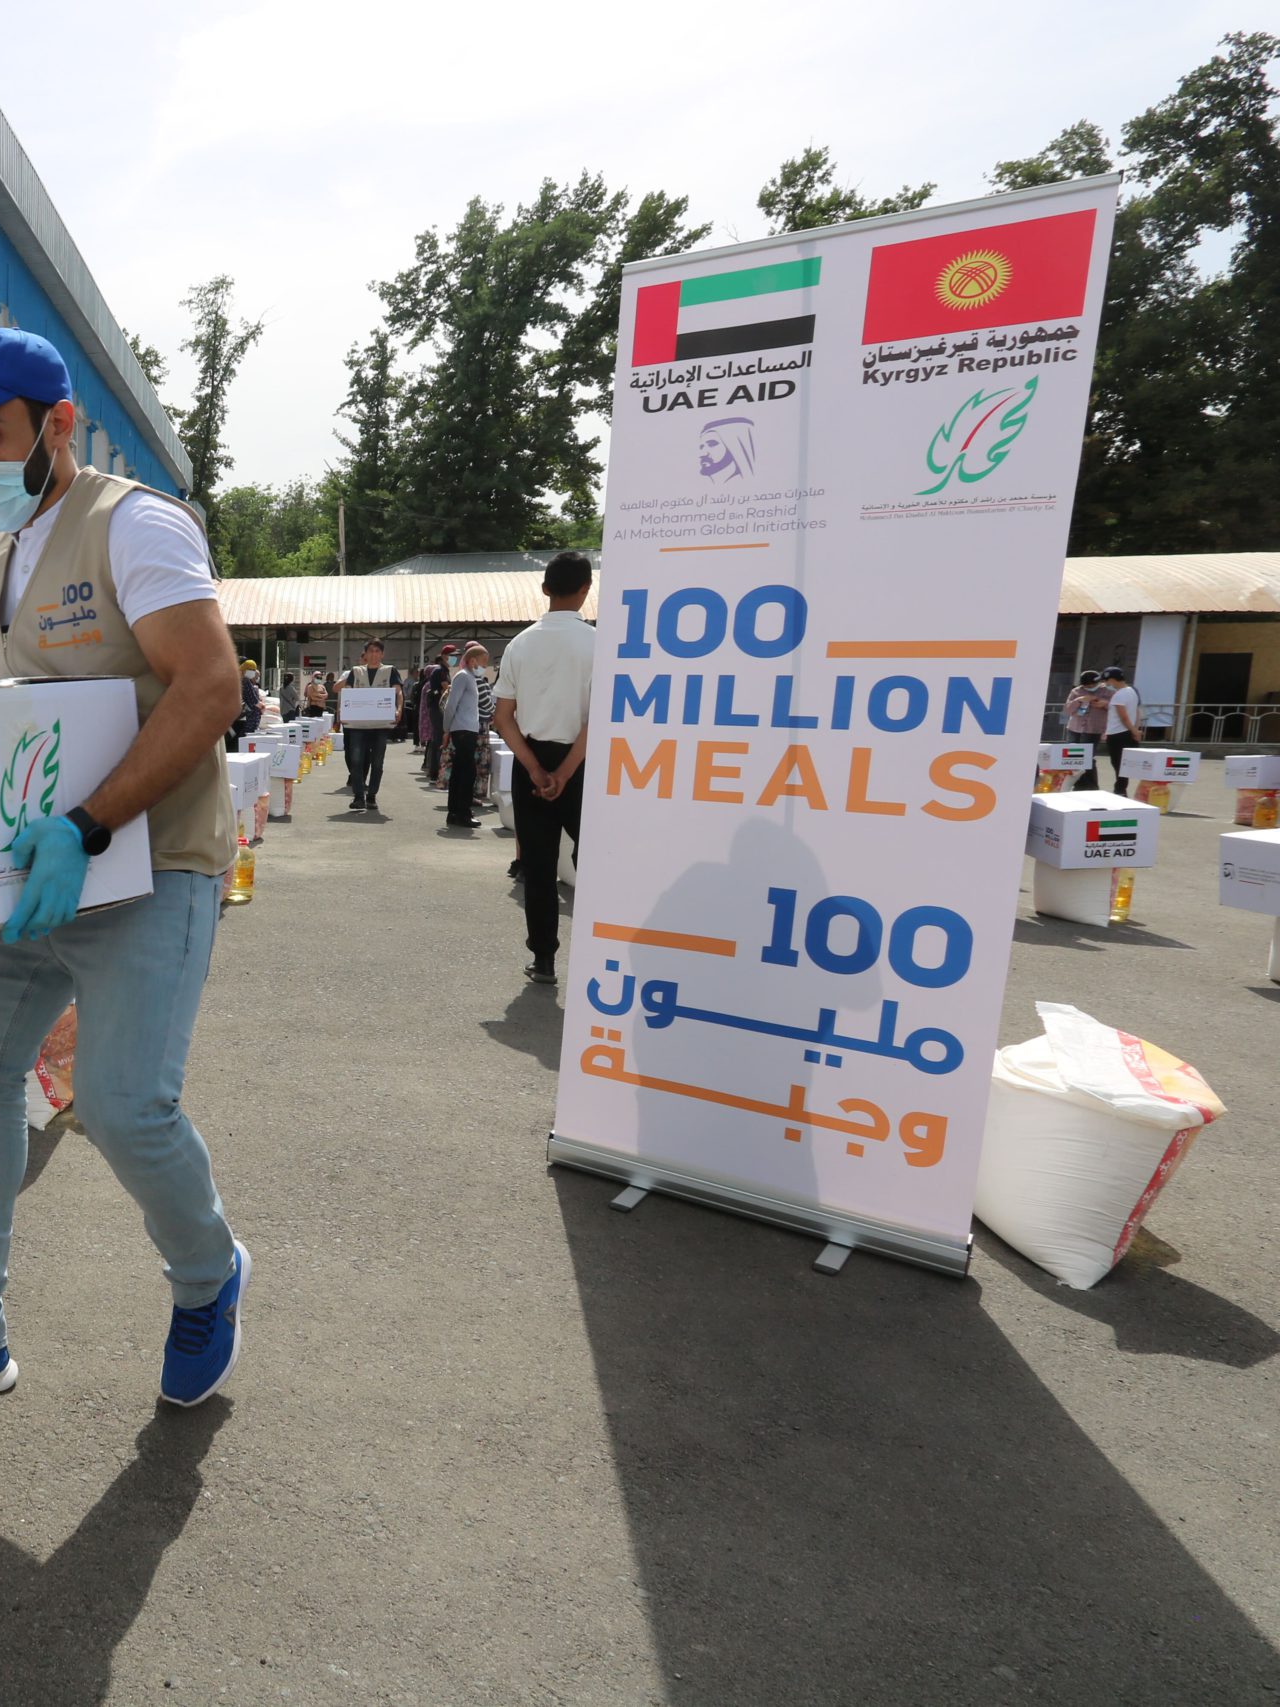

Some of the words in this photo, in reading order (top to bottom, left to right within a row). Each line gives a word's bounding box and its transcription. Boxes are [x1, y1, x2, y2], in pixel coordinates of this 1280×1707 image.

[862, 332, 979, 369] قيرغيزستان
[986, 324, 1080, 352] جمهورية
[629, 365, 702, 393] الإماراتية
[706, 350, 813, 380] المساعدات
[862, 364, 949, 387] Kyrgyz
[957, 348, 1079, 374] Republic
[642, 388, 719, 414] UAE
[726, 379, 796, 405] AID
[737, 495, 750, 505] بن
[752, 491, 782, 501] محمد
[613, 529, 626, 541] Al
[630, 525, 696, 540] Maktoum
[700, 521, 749, 537] Global
[752, 518, 827, 534] Initiatives
[640, 509, 726, 526] Mohammed
[728, 512, 744, 520] Bin
[746, 504, 797, 519] Rashid
[62, 582, 94, 606] 100
[39, 605, 97, 631] مليون
[617, 584, 809, 659] 100
[610, 673, 1013, 736] MILLION
[606, 737, 998, 822] MEALS
[1084, 849, 1111, 858] UAE
[1113, 848, 1136, 857] AID
[760, 886, 973, 988] 100
[586, 959, 964, 1075] مليون
[580, 1025, 948, 1168] وجبة
